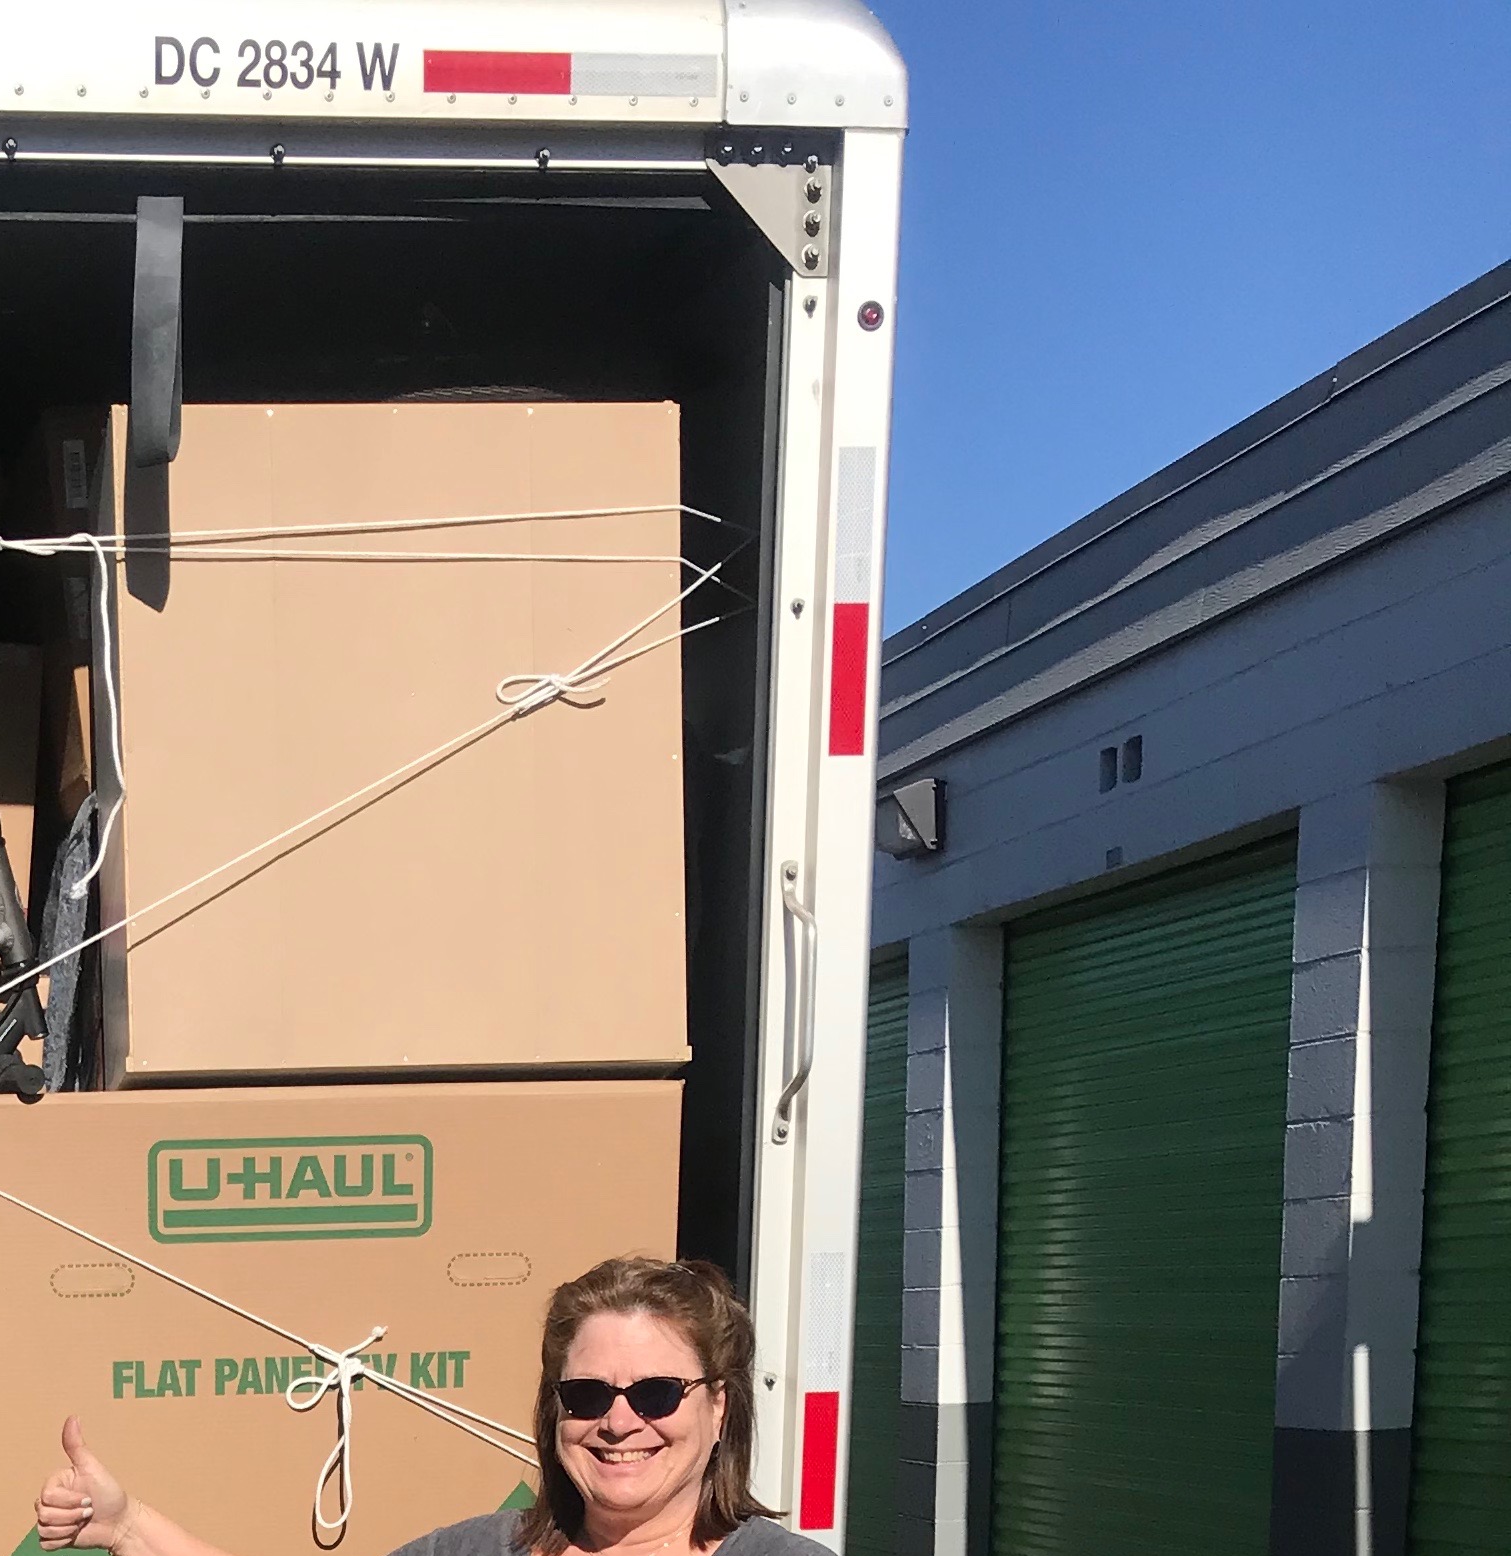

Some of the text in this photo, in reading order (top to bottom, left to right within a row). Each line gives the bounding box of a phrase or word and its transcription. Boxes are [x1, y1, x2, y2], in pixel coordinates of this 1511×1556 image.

[155, 36, 399, 91] DC 2834 W
[169, 1153, 413, 1201] U-HAUL
[113, 1359, 201, 1398] FLAT
[410, 1350, 470, 1389] KIT
